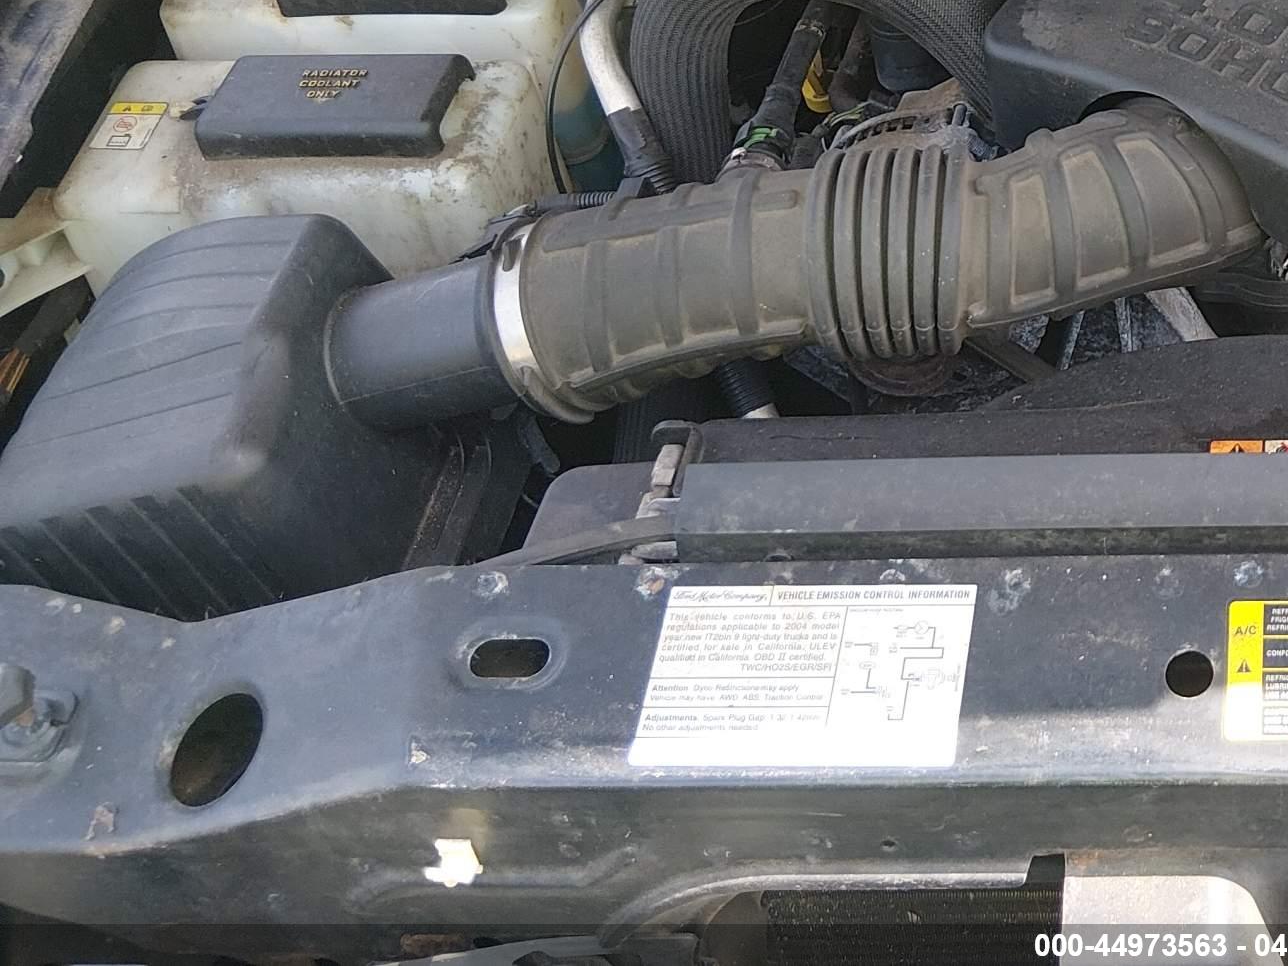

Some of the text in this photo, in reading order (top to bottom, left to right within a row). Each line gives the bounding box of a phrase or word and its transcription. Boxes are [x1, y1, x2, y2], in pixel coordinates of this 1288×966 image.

[302, 69, 368, 77] RADIATOR
[306, 90, 341, 98] ONLY
[673, 592, 723, 602] Ford Motor
[777, 590, 970, 600] VEHICLE EMISSION CONTROL INFORMATION
[669, 612, 842, 621] This vehicle conforms to EPA
[666, 622, 840, 632] regulations applicable to 2004 model
[1234, 625, 1256, 635] A/C
[742, 633, 780, 643] light-duty
[783, 632, 808, 640] trucks
[811, 632, 828, 640] and
[830, 632, 838, 640] is
[661, 642, 838, 652] certified for sale in ULEV
[754, 653, 775, 662] OBD
